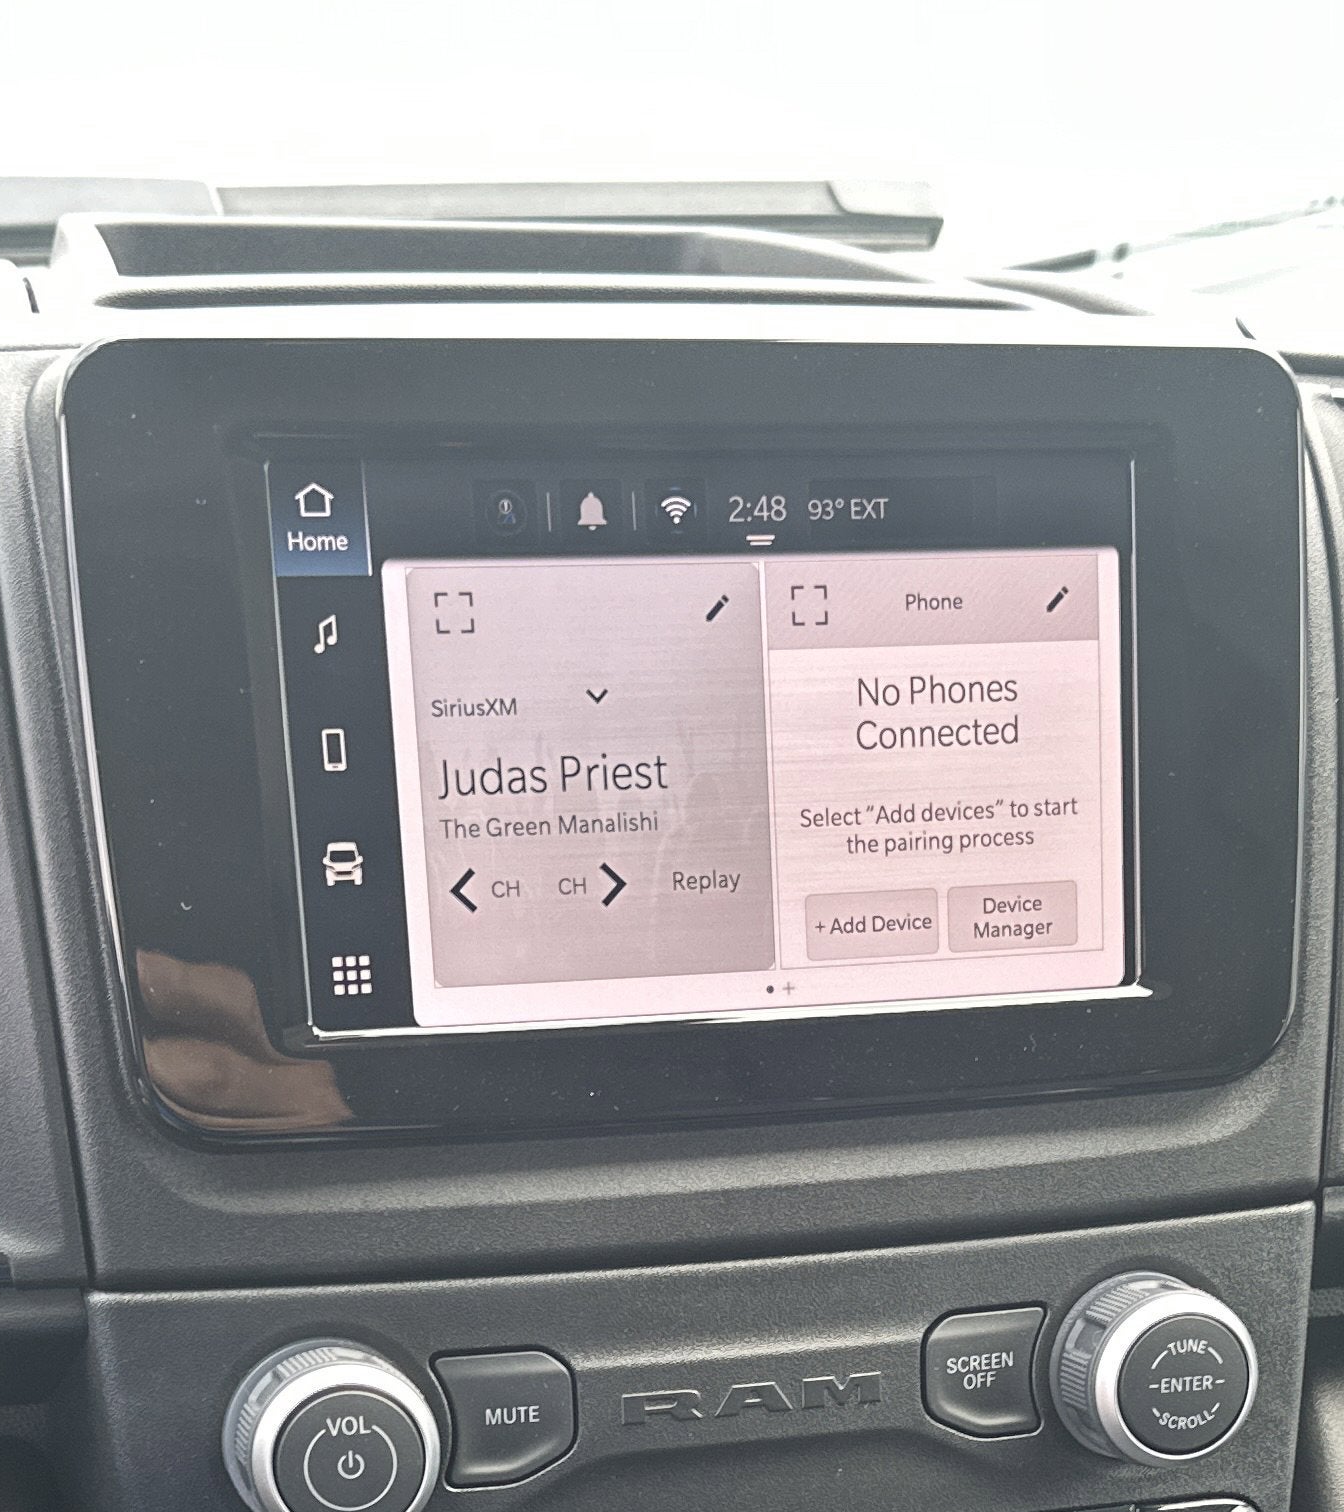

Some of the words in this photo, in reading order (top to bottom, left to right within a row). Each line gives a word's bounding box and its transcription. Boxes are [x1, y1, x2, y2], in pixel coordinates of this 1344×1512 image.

[729, 495, 787, 522] 2:48
[807, 498, 844, 520] 93°
[850, 498, 889, 520] EXT
[287, 531, 349, 551] Home
[905, 593, 963, 611] Phone
[857, 677, 900, 707] No
[910, 675, 1018, 705] Phones
[431, 697, 518, 718] SiriusXM
[856, 715, 1019, 750] Connected
[438, 757, 547, 800] Judas
[560, 753, 669, 792] Priest
[800, 807, 861, 829] Select
[1009, 800, 1029, 818] to
[1033, 797, 1078, 817] start
[439, 818, 481, 839] The
[485, 816, 551, 838] Green
[558, 811, 659, 835] Manalishi
[846, 834, 878, 855] the
[885, 830, 953, 857] pairing
[959, 828, 1034, 853] process
[491, 881, 521, 898] CH
[558, 877, 587, 896] CH
[672, 869, 742, 893] Replay
[983, 895, 1042, 914] Device
[829, 915, 866, 935] Add
[872, 913, 932, 933] Device
[973, 919, 1053, 941] Manager
[1167, 1338, 1209, 1356] TUNE
[946, 1351, 1014, 1375] SCREEN
[963, 1372, 997, 1391] OFF
[1160, 1377, 1213, 1394] ENTER
[622, 1371, 882, 1425] RAM
[326, 1415, 372, 1437] VOL
[485, 1405, 540, 1426] MUTE
[1158, 1410, 1215, 1430] SCROLL
